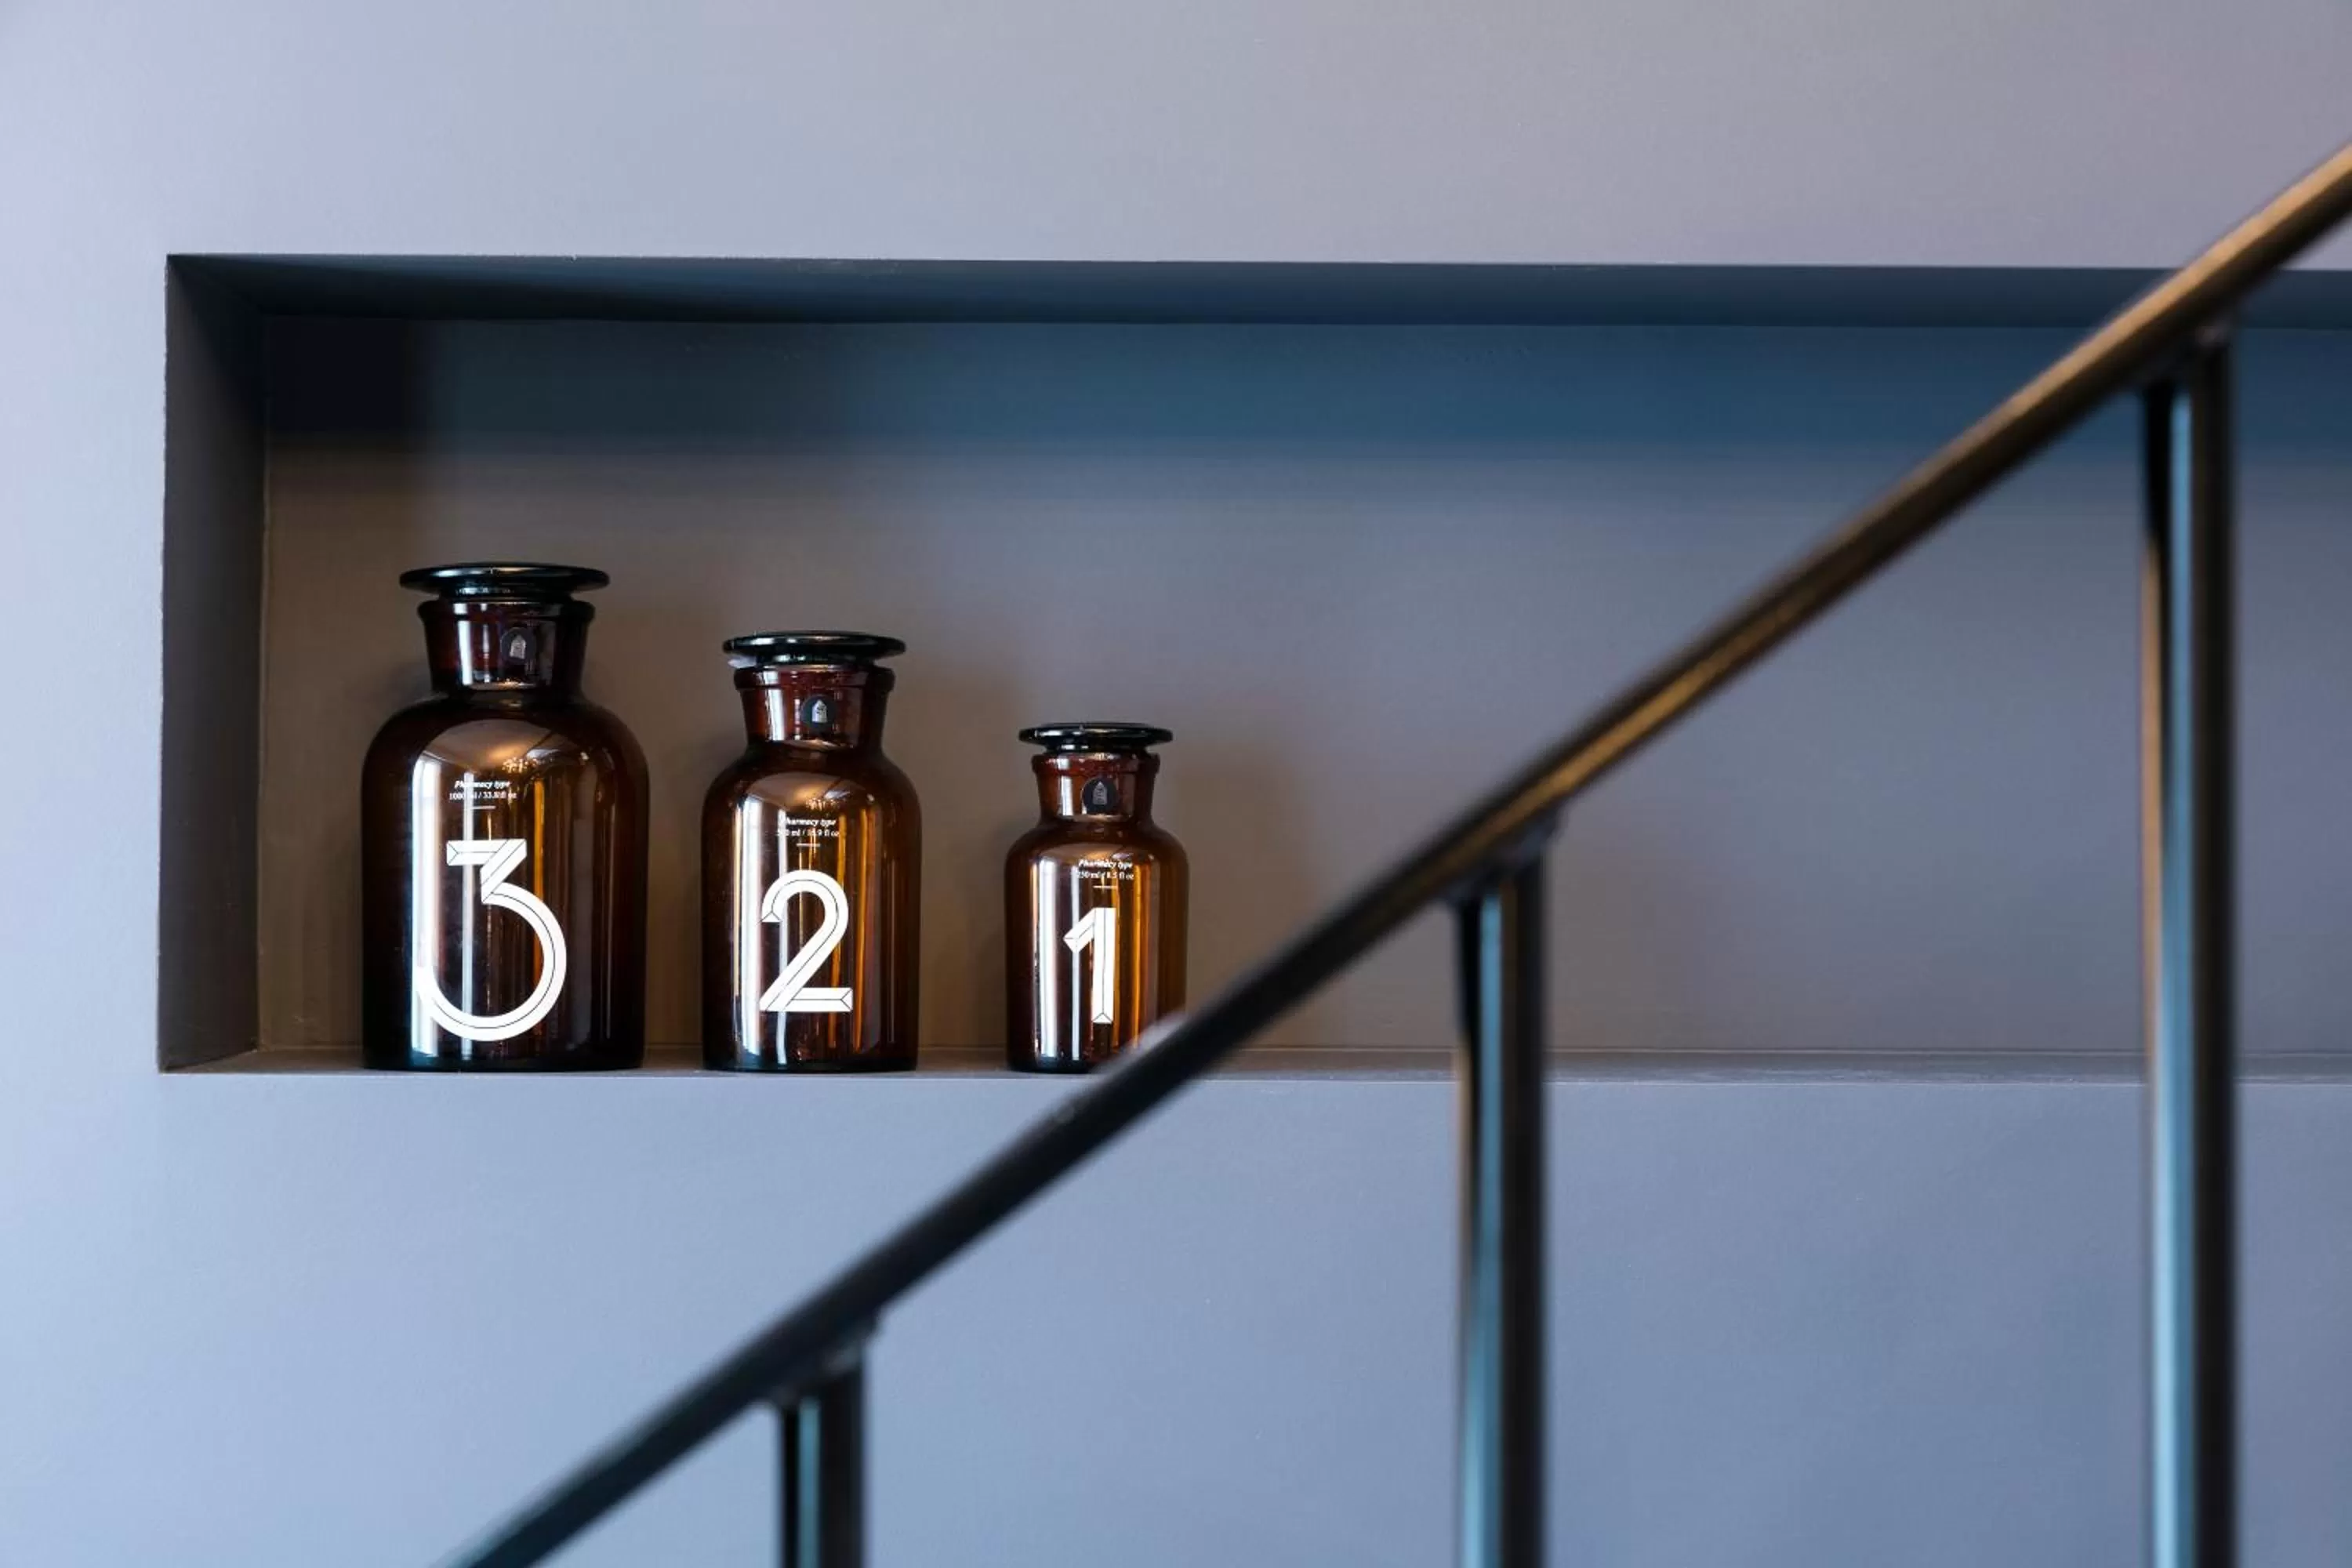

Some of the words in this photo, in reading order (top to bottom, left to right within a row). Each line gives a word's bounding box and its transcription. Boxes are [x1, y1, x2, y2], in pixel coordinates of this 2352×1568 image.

[494, 780, 510, 789] type
[819, 818, 837, 828] type
[1117, 860, 1133, 869] type
[416, 838, 567, 1042] 3
[759, 869, 854, 1012] 2
[1063, 907, 1116, 1024] 1
